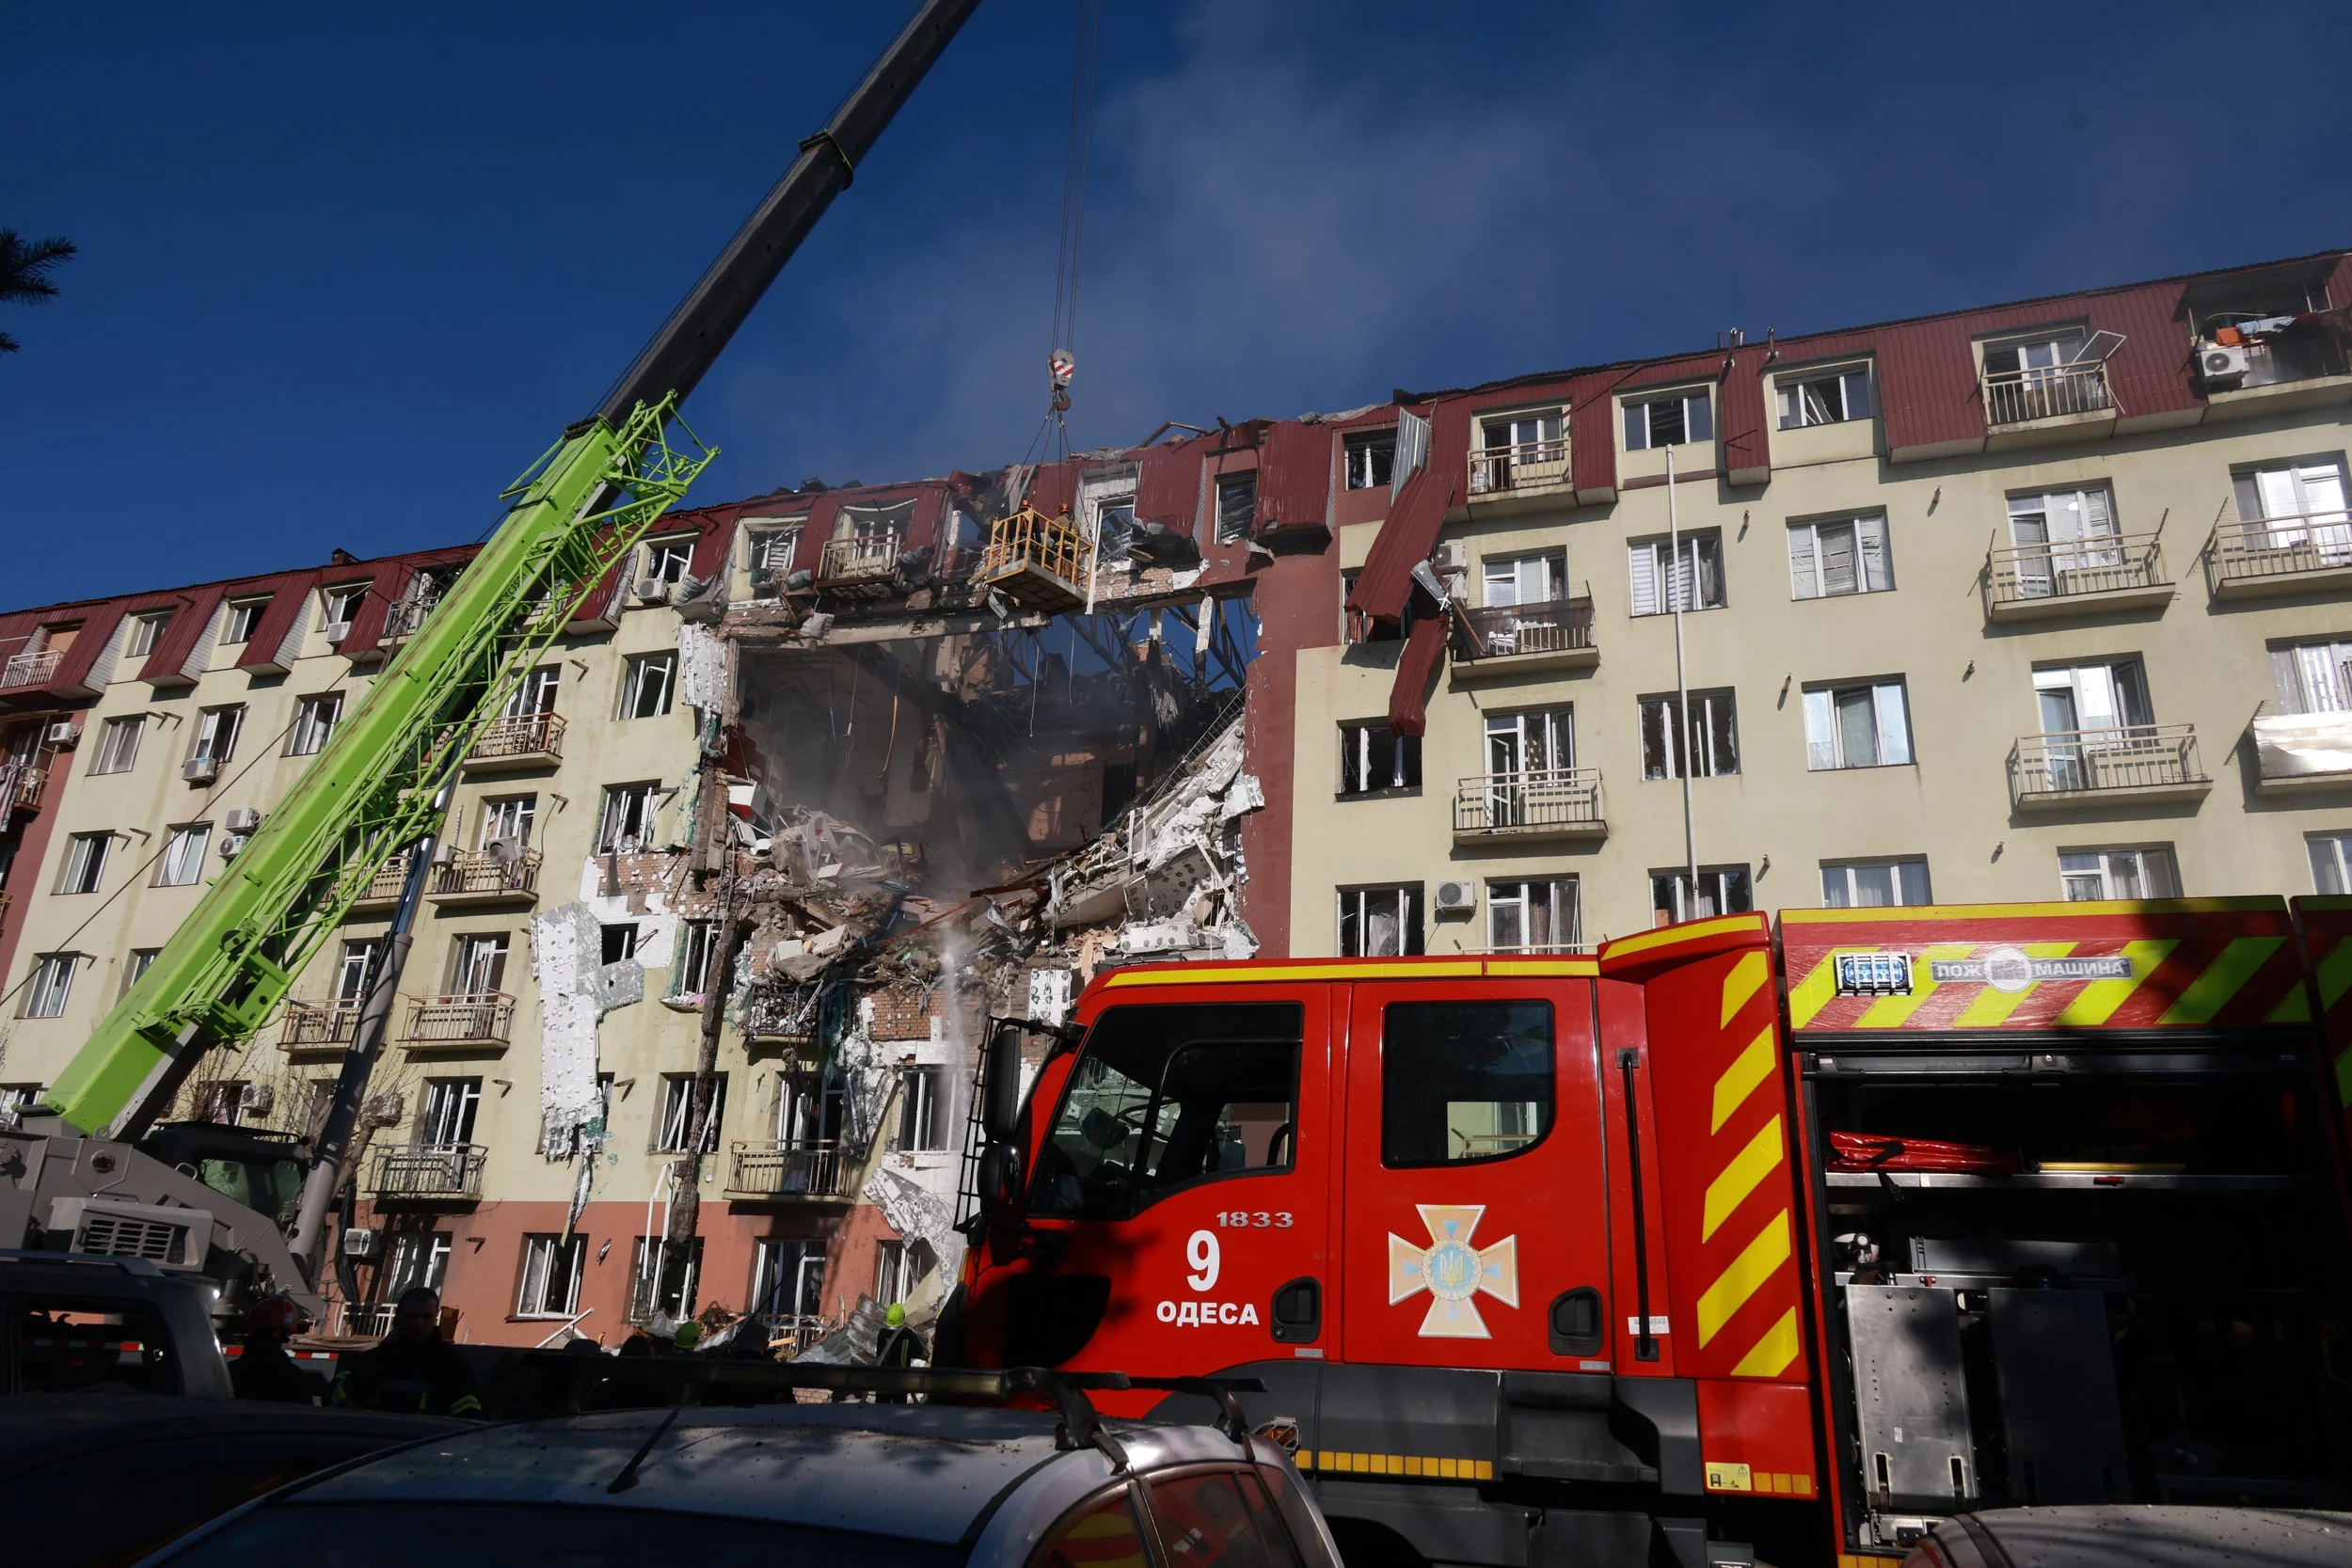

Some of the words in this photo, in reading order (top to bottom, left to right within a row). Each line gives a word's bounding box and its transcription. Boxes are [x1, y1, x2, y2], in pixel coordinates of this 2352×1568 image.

[1937, 964, 1982, 977] ПОЖ
[2035, 961, 2125, 976] МАШИНА
[1216, 1212, 1294, 1228] 1833
[1186, 1229, 1221, 1292] 9
[1156, 1300, 1260, 1327] ОДЕСА
